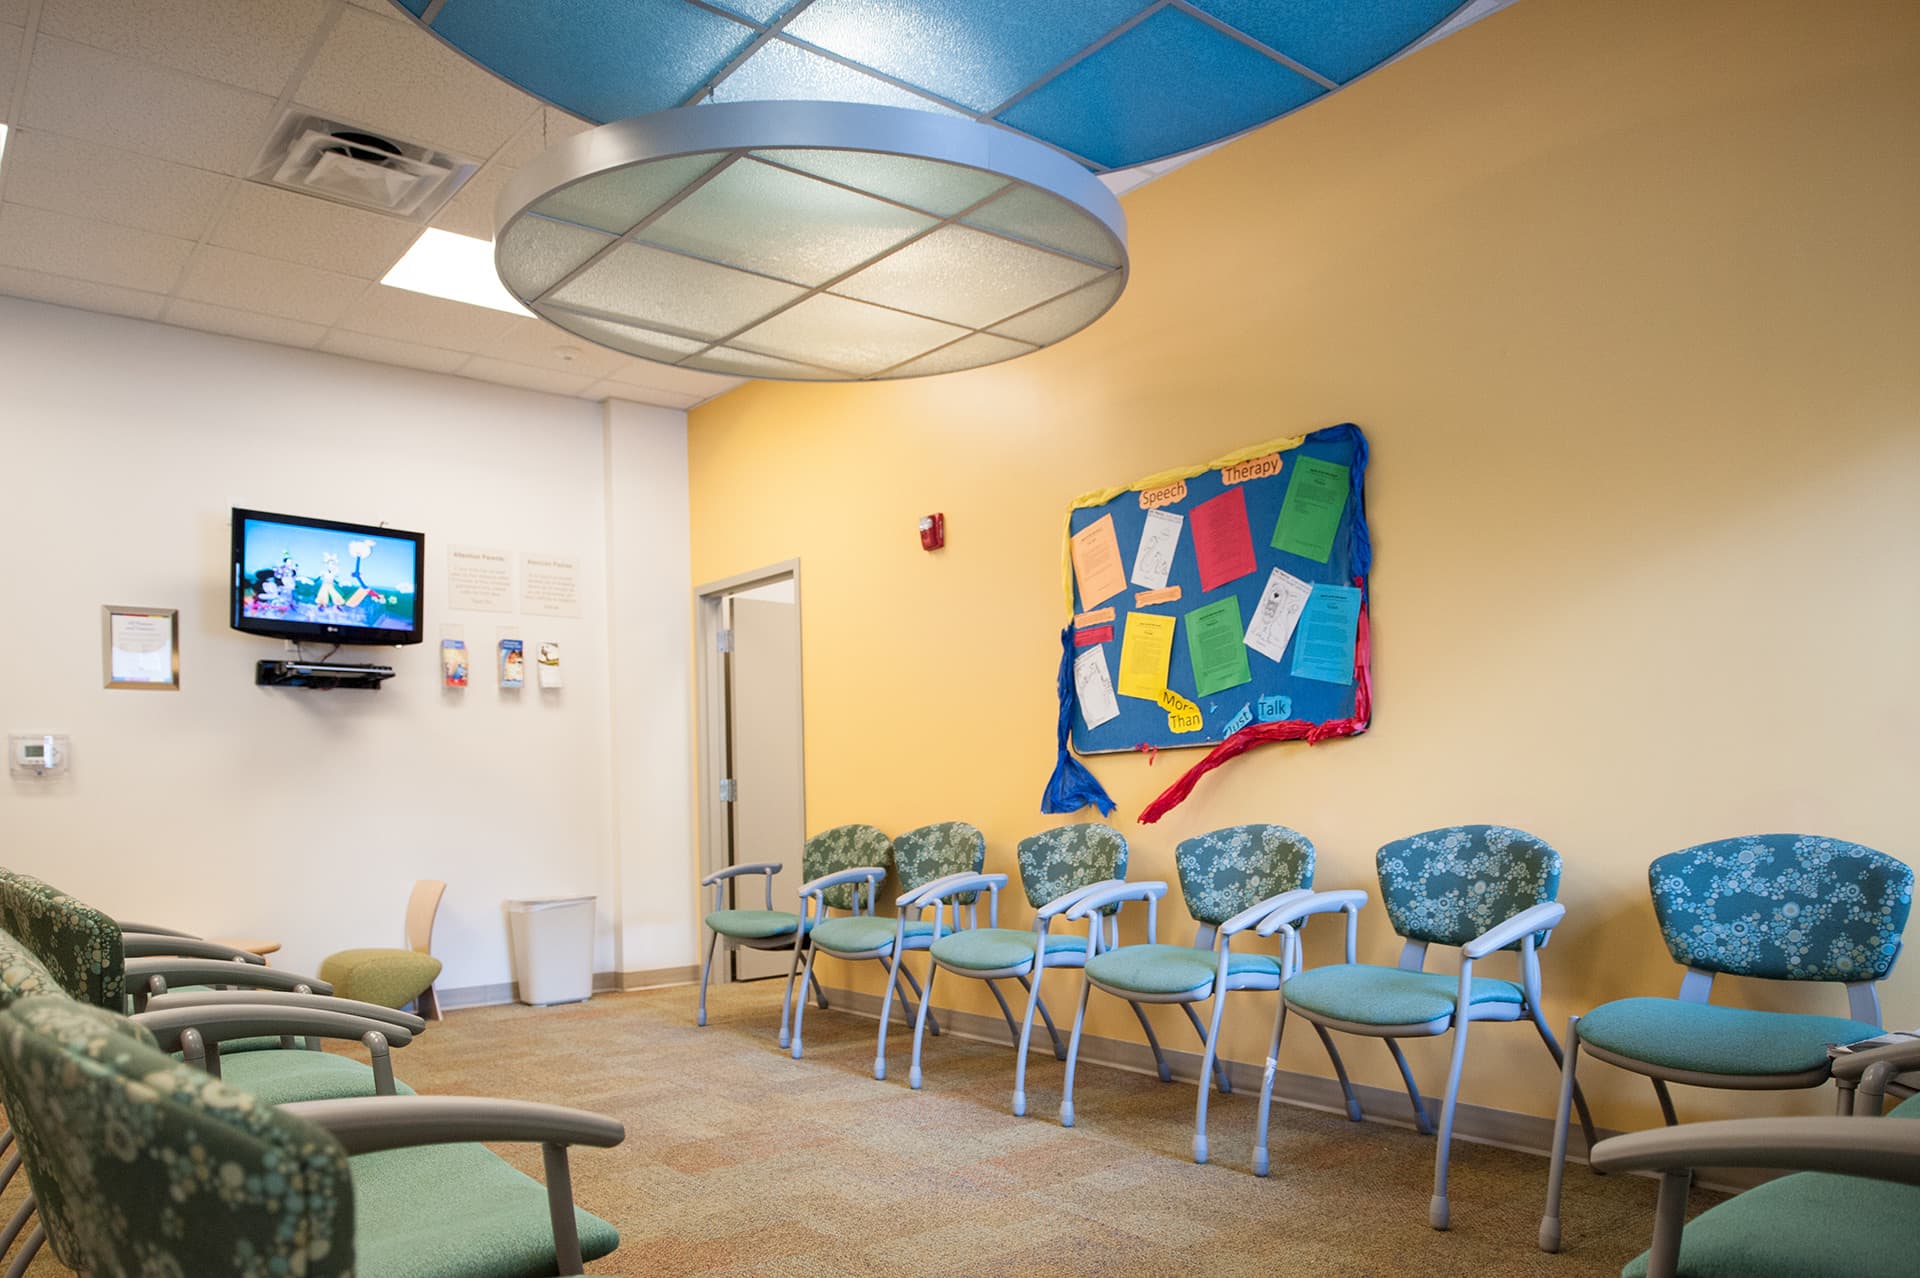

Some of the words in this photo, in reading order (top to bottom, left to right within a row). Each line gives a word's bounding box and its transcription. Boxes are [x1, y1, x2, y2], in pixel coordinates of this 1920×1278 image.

[1142, 482, 1185, 507] Speech
[1225, 458, 1279, 481] Therapy
[1259, 700, 1286, 716] Talk
[1169, 714, 1201, 728] Than
